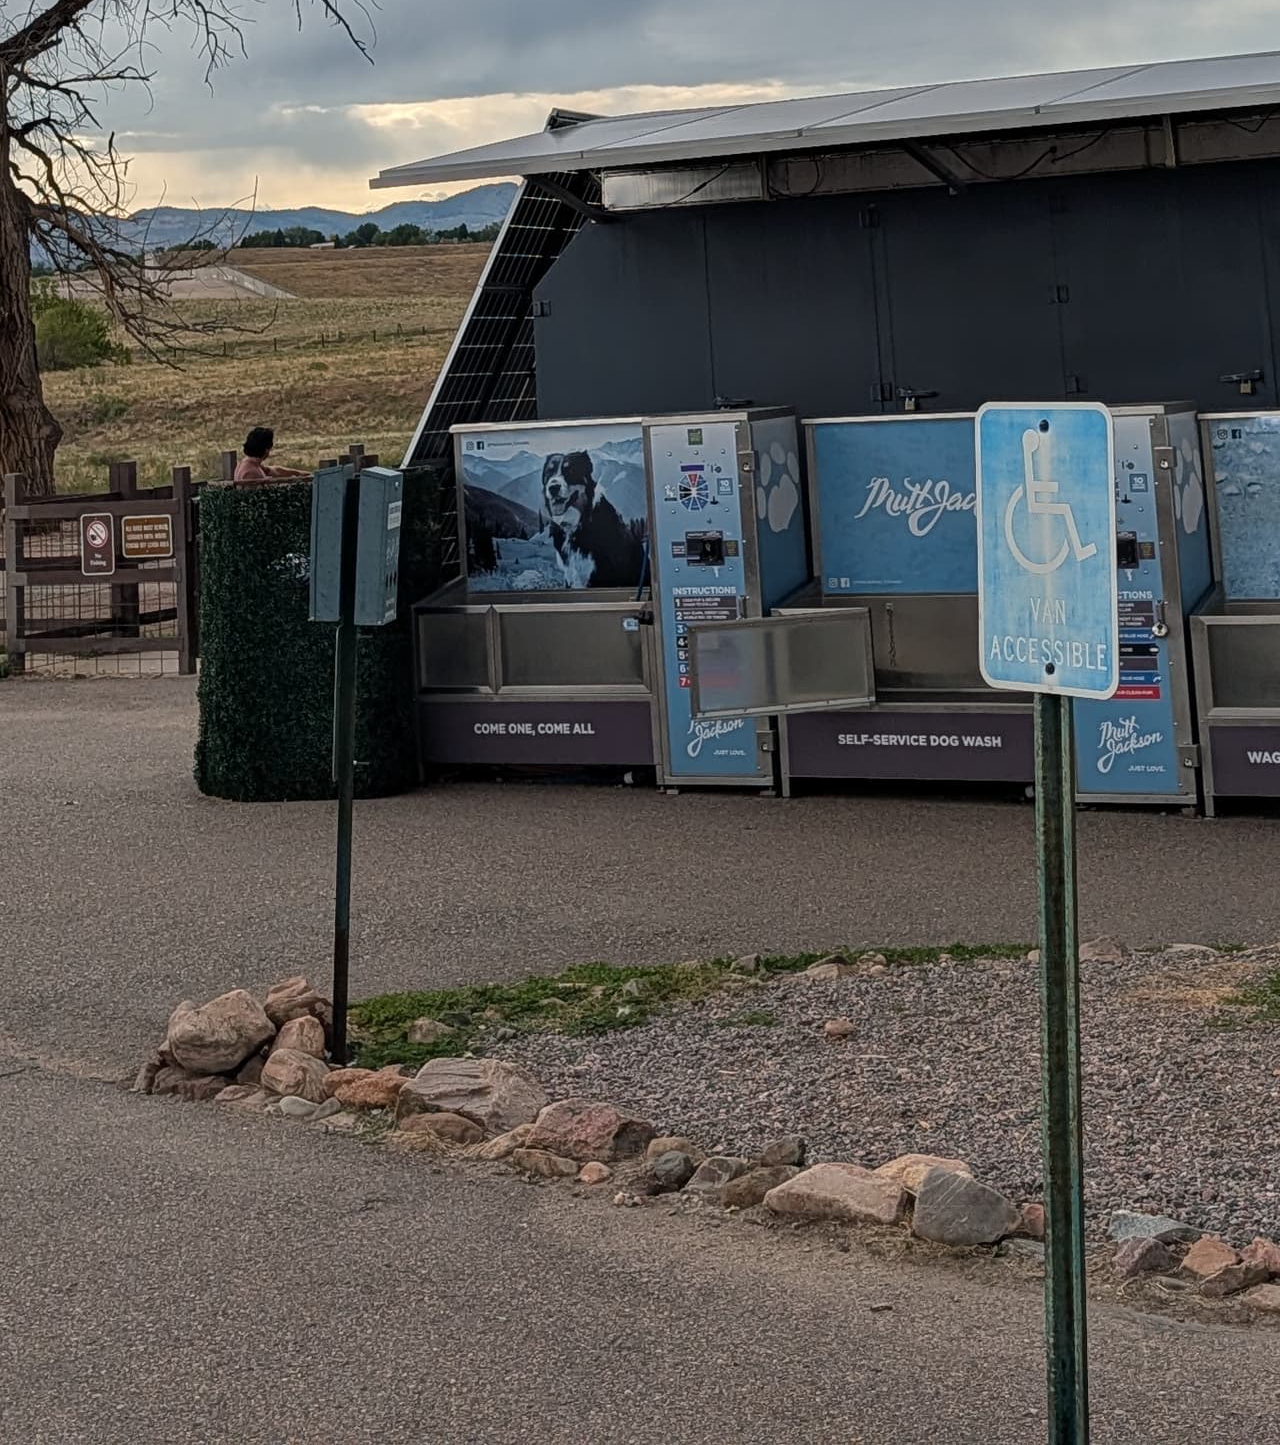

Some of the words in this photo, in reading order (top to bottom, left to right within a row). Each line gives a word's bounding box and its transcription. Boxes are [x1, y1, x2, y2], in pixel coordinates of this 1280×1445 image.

[854, 476, 934, 519] Mutt
[908, 480, 977, 537] Jac
[672, 586, 737, 595] INSTRUCTIONS
[675, 598, 680, 607] 1
[676, 612, 682, 620] 2
[1030, 597, 1066, 625] VAN
[677, 624, 683, 633] 3
[678, 637, 685, 646] 4
[679, 650, 685, 659] 5
[990, 635, 1107, 671] ACCESSIBLE
[679, 664, 686, 673] 6
[680, 677, 687, 686] 7
[473, 723, 506, 734] COME
[508, 723, 536, 736] ONE,
[537, 723, 570, 734] COME
[572, 723, 596, 734] ALL
[1097, 715, 1140, 748] Mutt
[687, 719, 745, 757] Jackson
[838, 734, 927, 746] SELF-SERVICE
[929, 735, 959, 747] DOG
[961, 735, 1001, 747] WASH
[1097, 732, 1163, 774] Jackson
